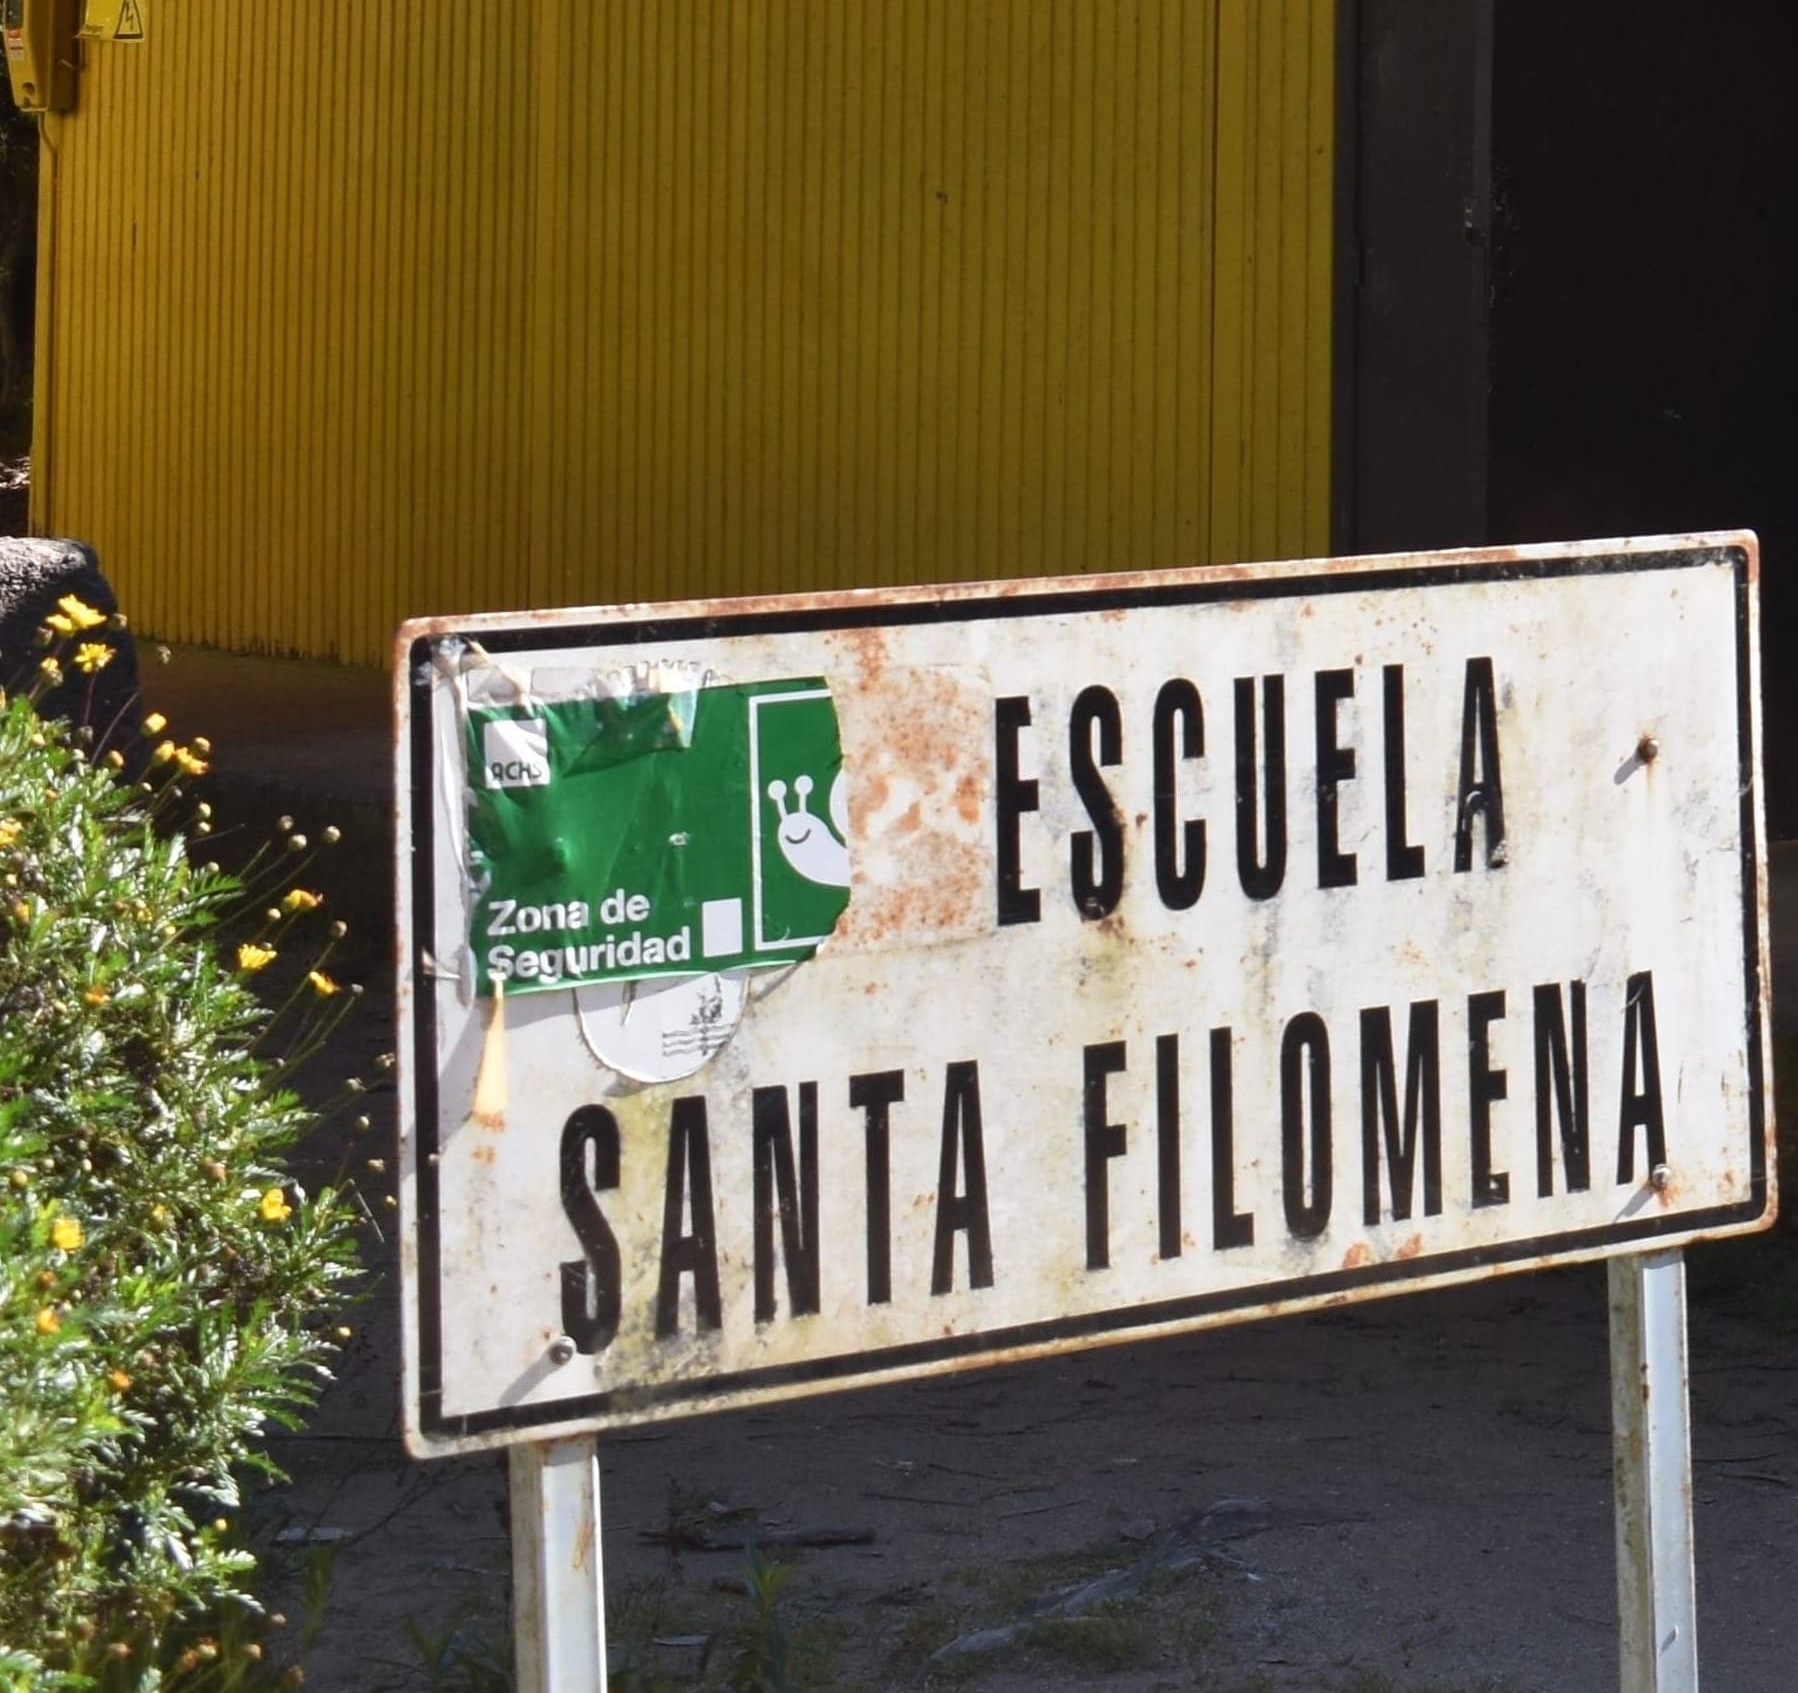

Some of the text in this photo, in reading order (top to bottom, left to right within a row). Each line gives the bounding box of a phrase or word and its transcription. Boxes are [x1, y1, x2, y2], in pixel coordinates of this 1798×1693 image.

[994, 656, 1506, 927] ESCUELA
[487, 888, 651, 936] Zona de
[487, 925, 691, 985] Seguridad
[560, 971, 1667, 1355] SANTA FILOMENA
